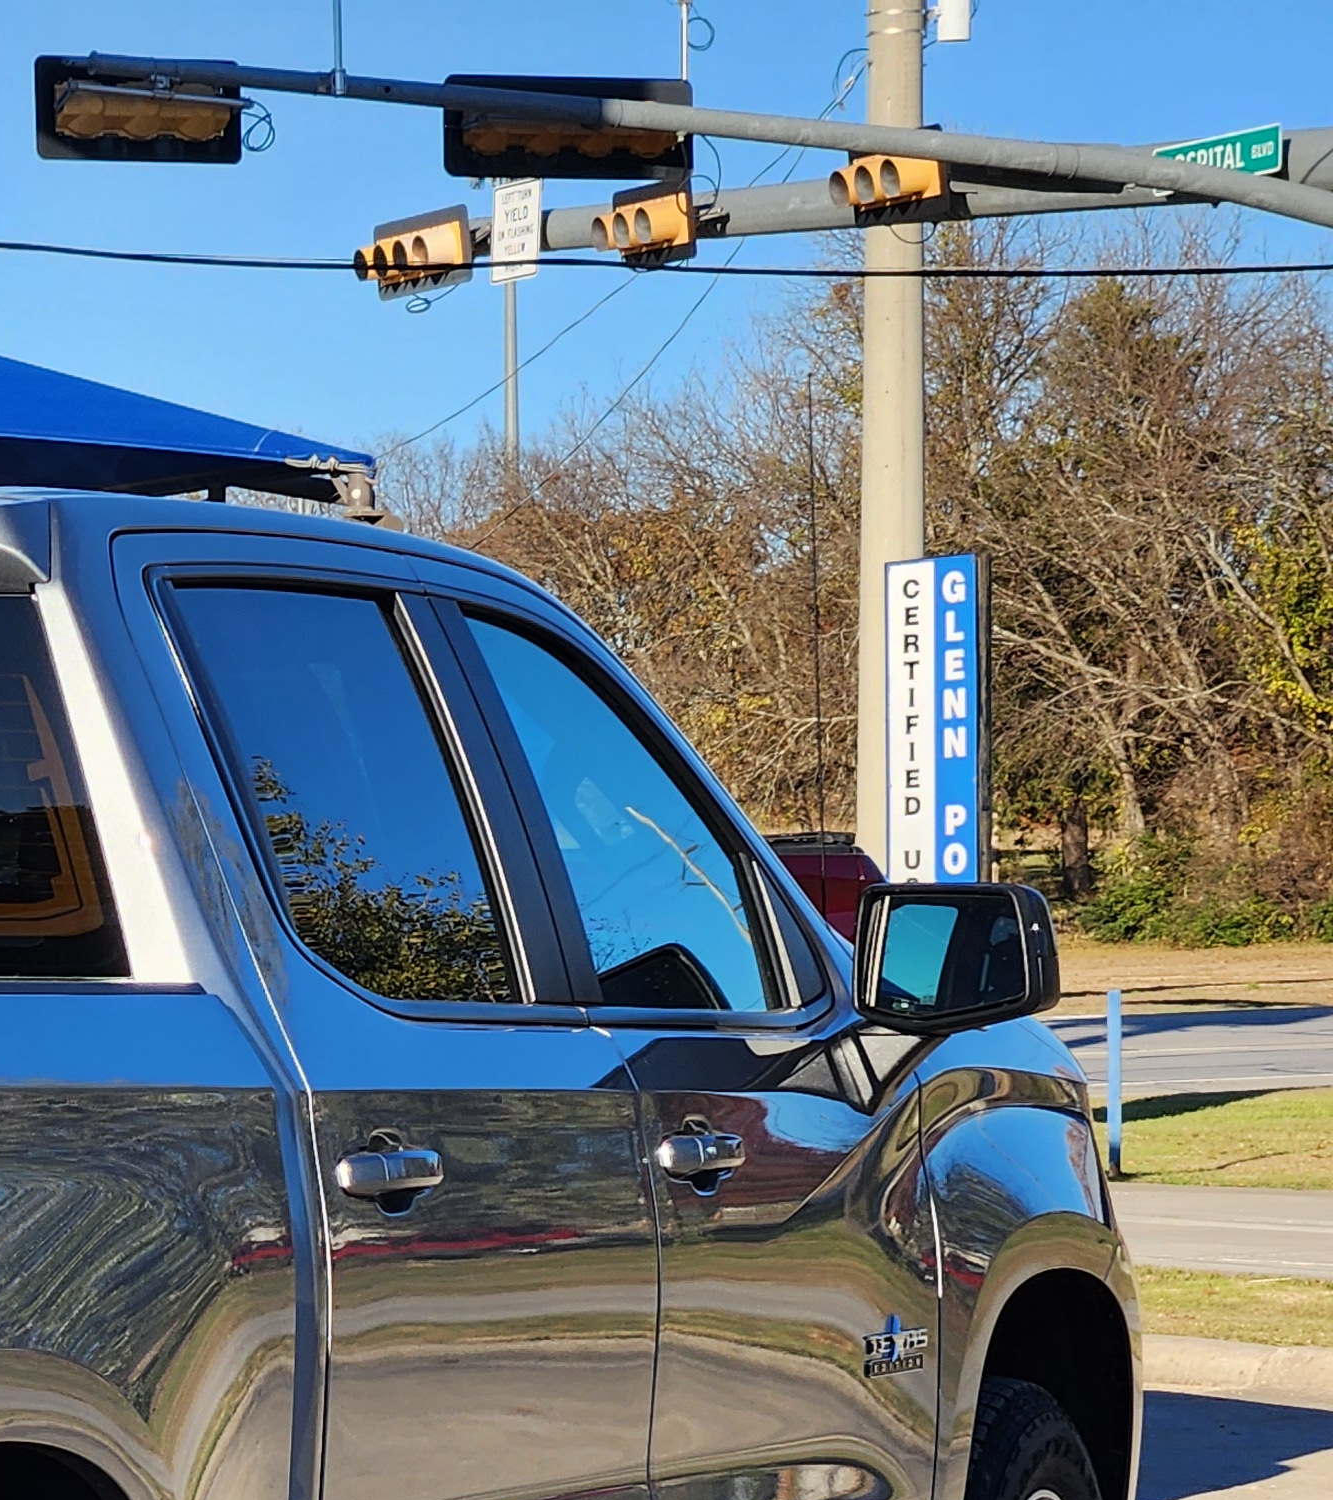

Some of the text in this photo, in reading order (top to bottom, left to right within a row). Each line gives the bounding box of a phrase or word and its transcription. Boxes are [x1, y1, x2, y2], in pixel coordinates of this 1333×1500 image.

[1251, 141, 1274, 159] BLVD
[502, 188, 532, 205] LEFT TURN
[504, 205, 529, 223] YIELD
[507, 224, 534, 239] FLASHING
[504, 242, 526, 256] YELLOW
[941, 570, 968, 759] GLENN
[903, 579, 922, 883] CERTIFIED U
